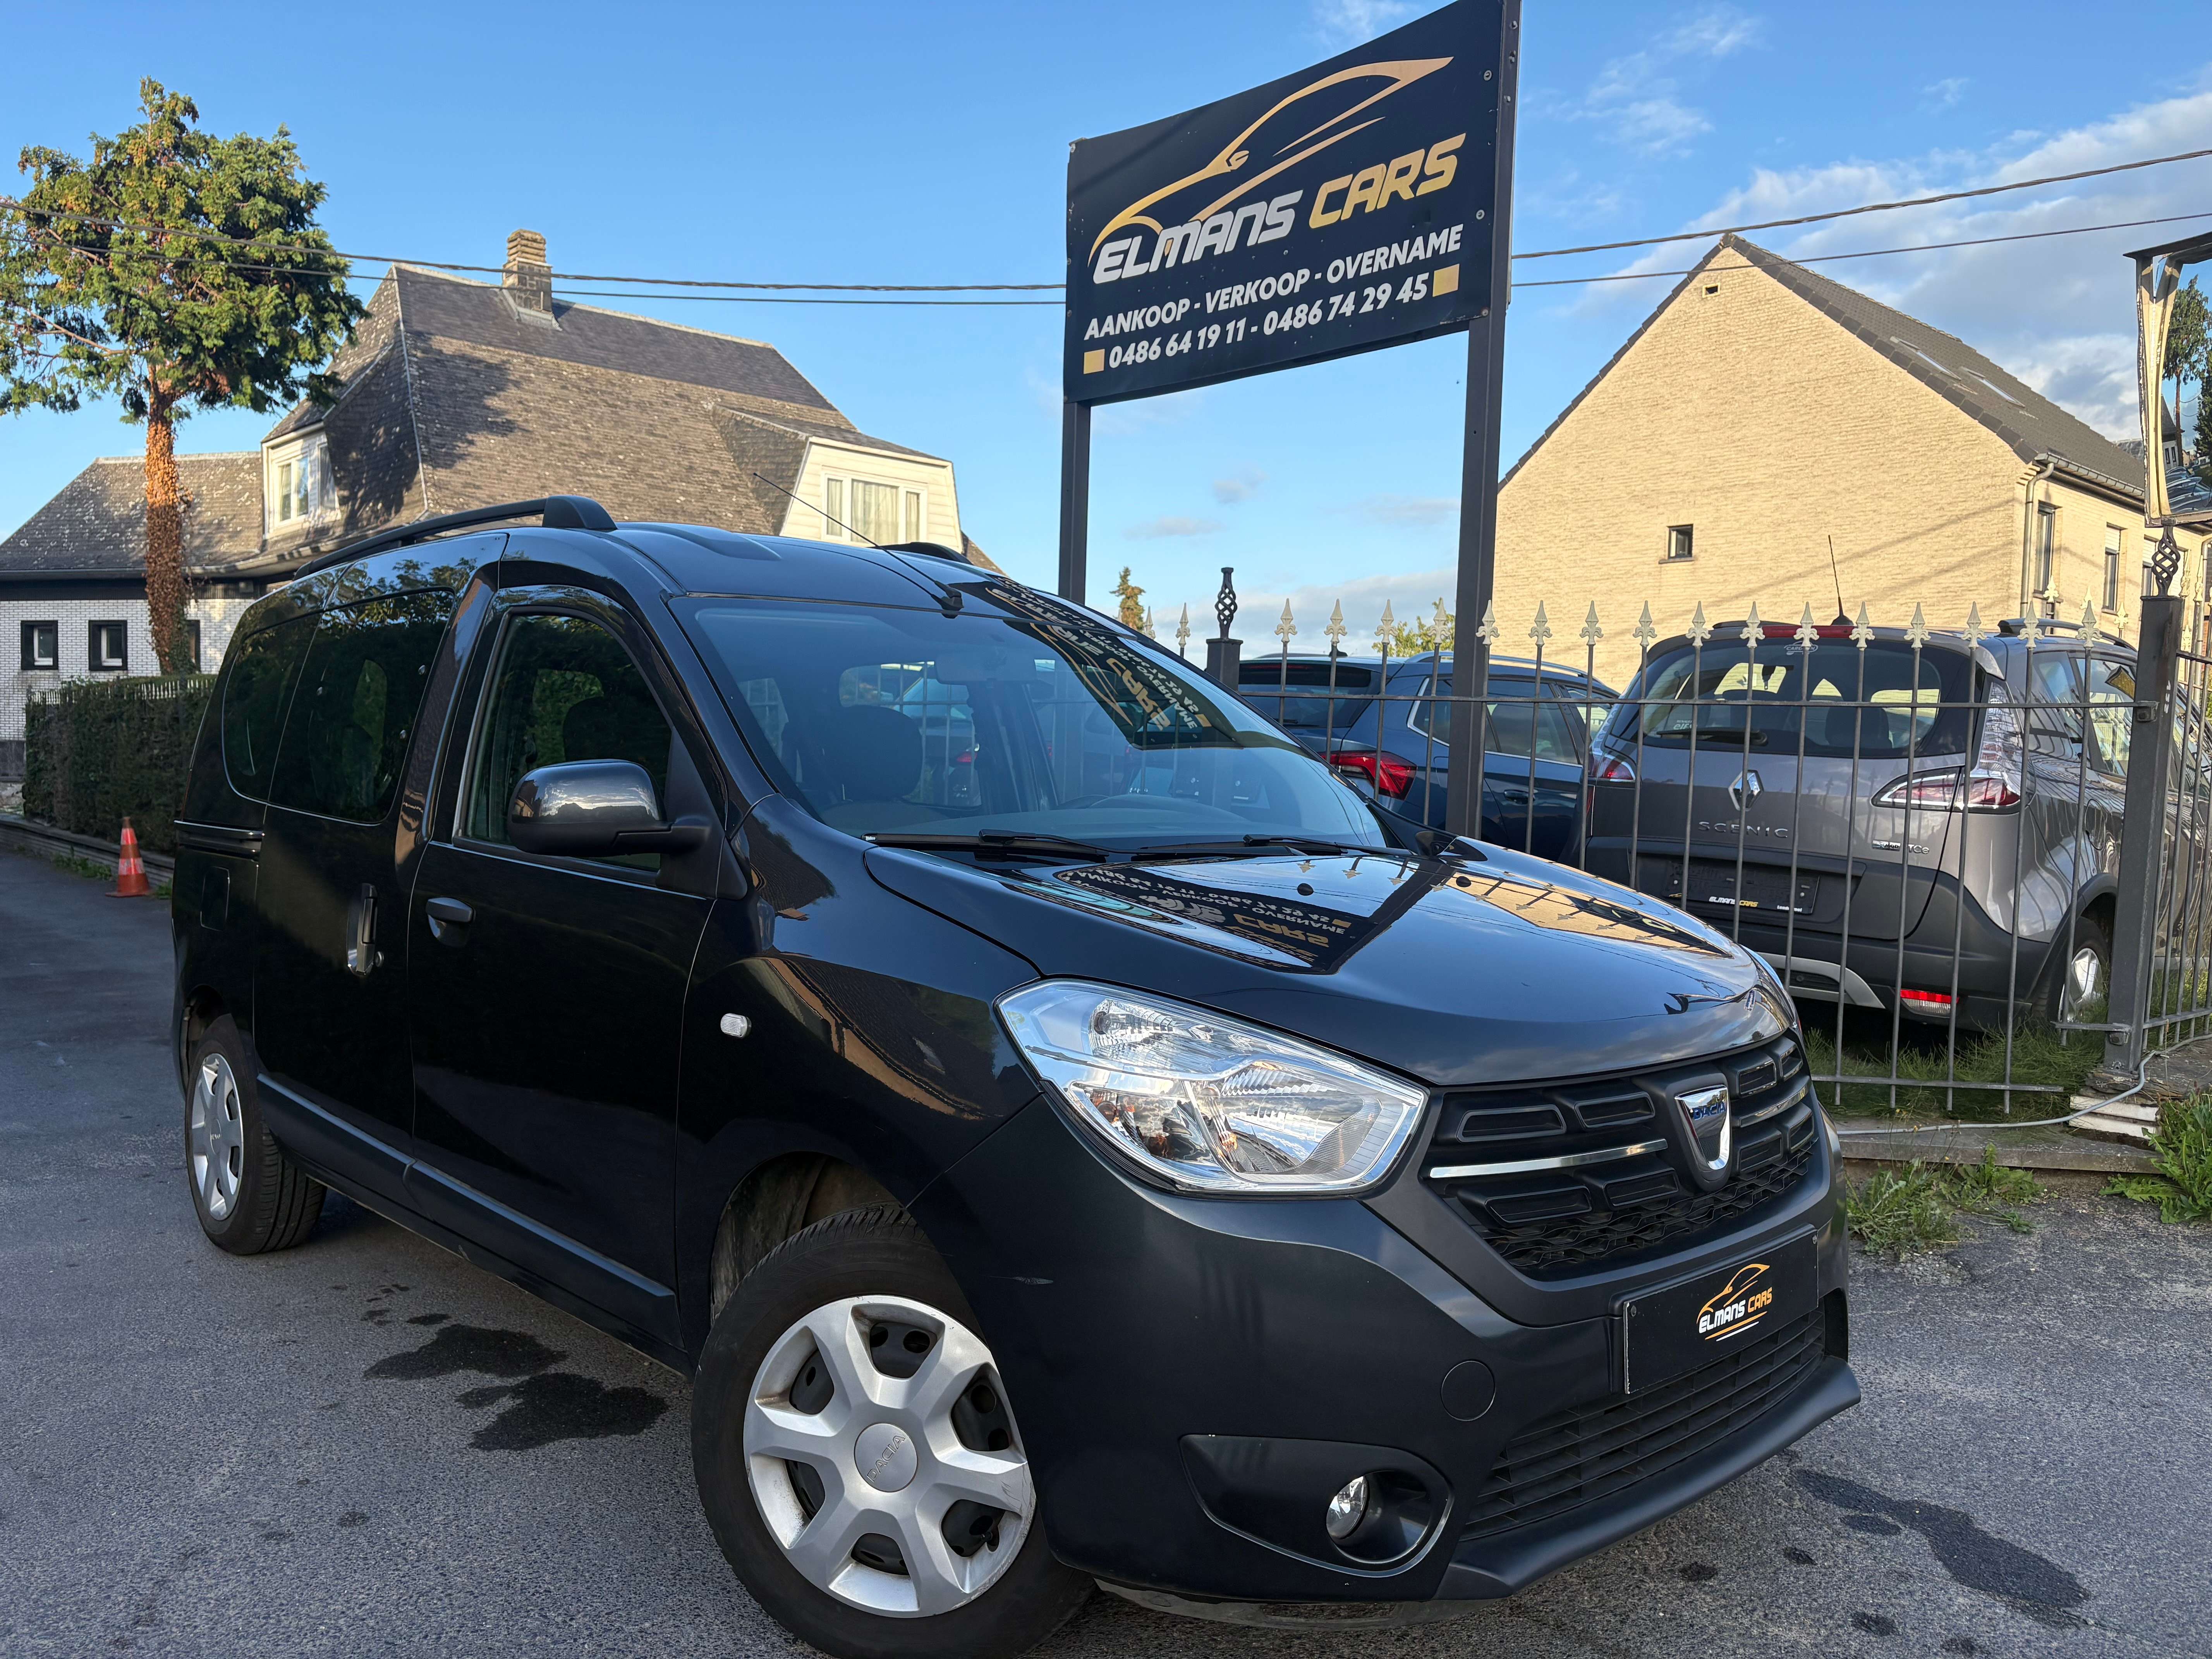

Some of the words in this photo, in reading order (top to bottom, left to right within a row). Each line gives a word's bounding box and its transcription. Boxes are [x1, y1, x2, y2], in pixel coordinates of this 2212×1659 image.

[1093, 190, 1303, 284] ELMANS
[1309, 133, 1466, 229] CARS
[1084, 298, 1190, 340] AANKOOP
[1206, 268, 1310, 313] VERKOOP
[1327, 223, 1463, 283] OVERNAME
[1109, 337, 1161, 368] 0486
[1165, 330, 1192, 357] 64
[1197, 324, 1221, 350] 19
[1226, 317, 1246, 343] 11
[1263, 299, 1323, 335] 0486
[1327, 291, 1356, 321] 74
[1358, 283, 1392, 314] 29
[1395, 272, 1429, 303] 45
[1698, 821, 1788, 838] SCENIC
[1693, 1101, 1726, 1120] DACIA
[1698, 1299, 1746, 1333] ELMANS
[1747, 1286, 1772, 1313] CARS
[866, 1434, 906, 1483] DACIA
